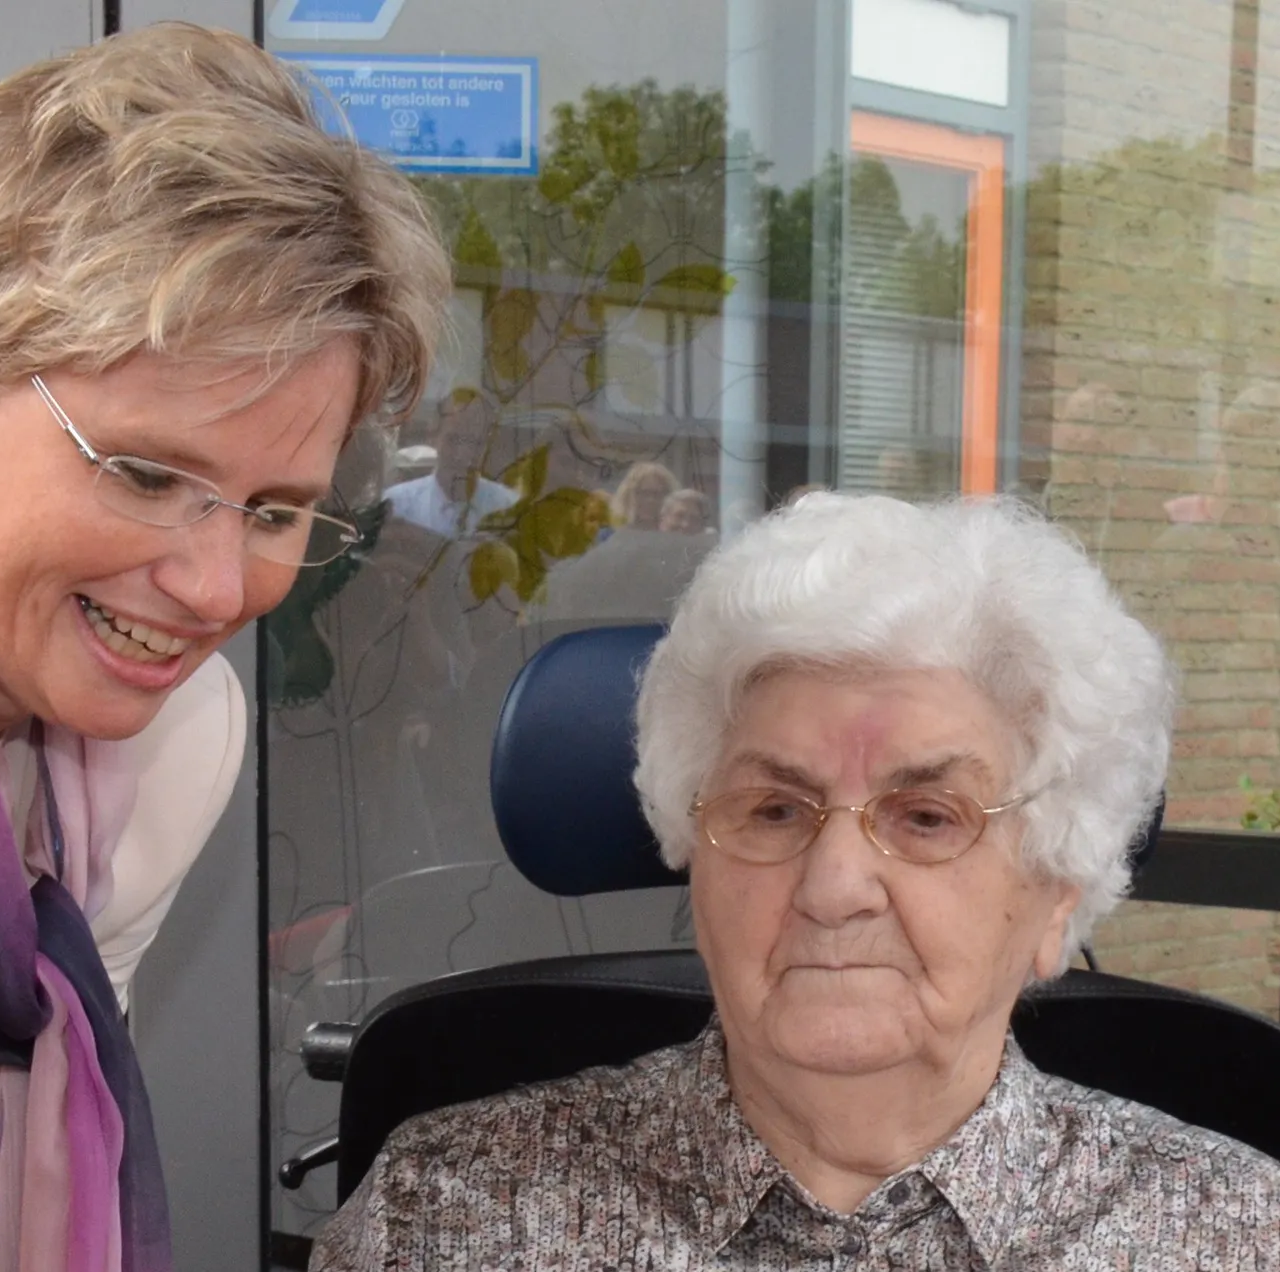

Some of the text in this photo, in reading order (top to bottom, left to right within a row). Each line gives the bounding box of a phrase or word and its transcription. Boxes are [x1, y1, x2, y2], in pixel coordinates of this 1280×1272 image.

[422, 77, 444, 90] tot
[449, 77, 504, 92] andere
[381, 92, 451, 109] gesloten
[456, 94, 470, 107] is
